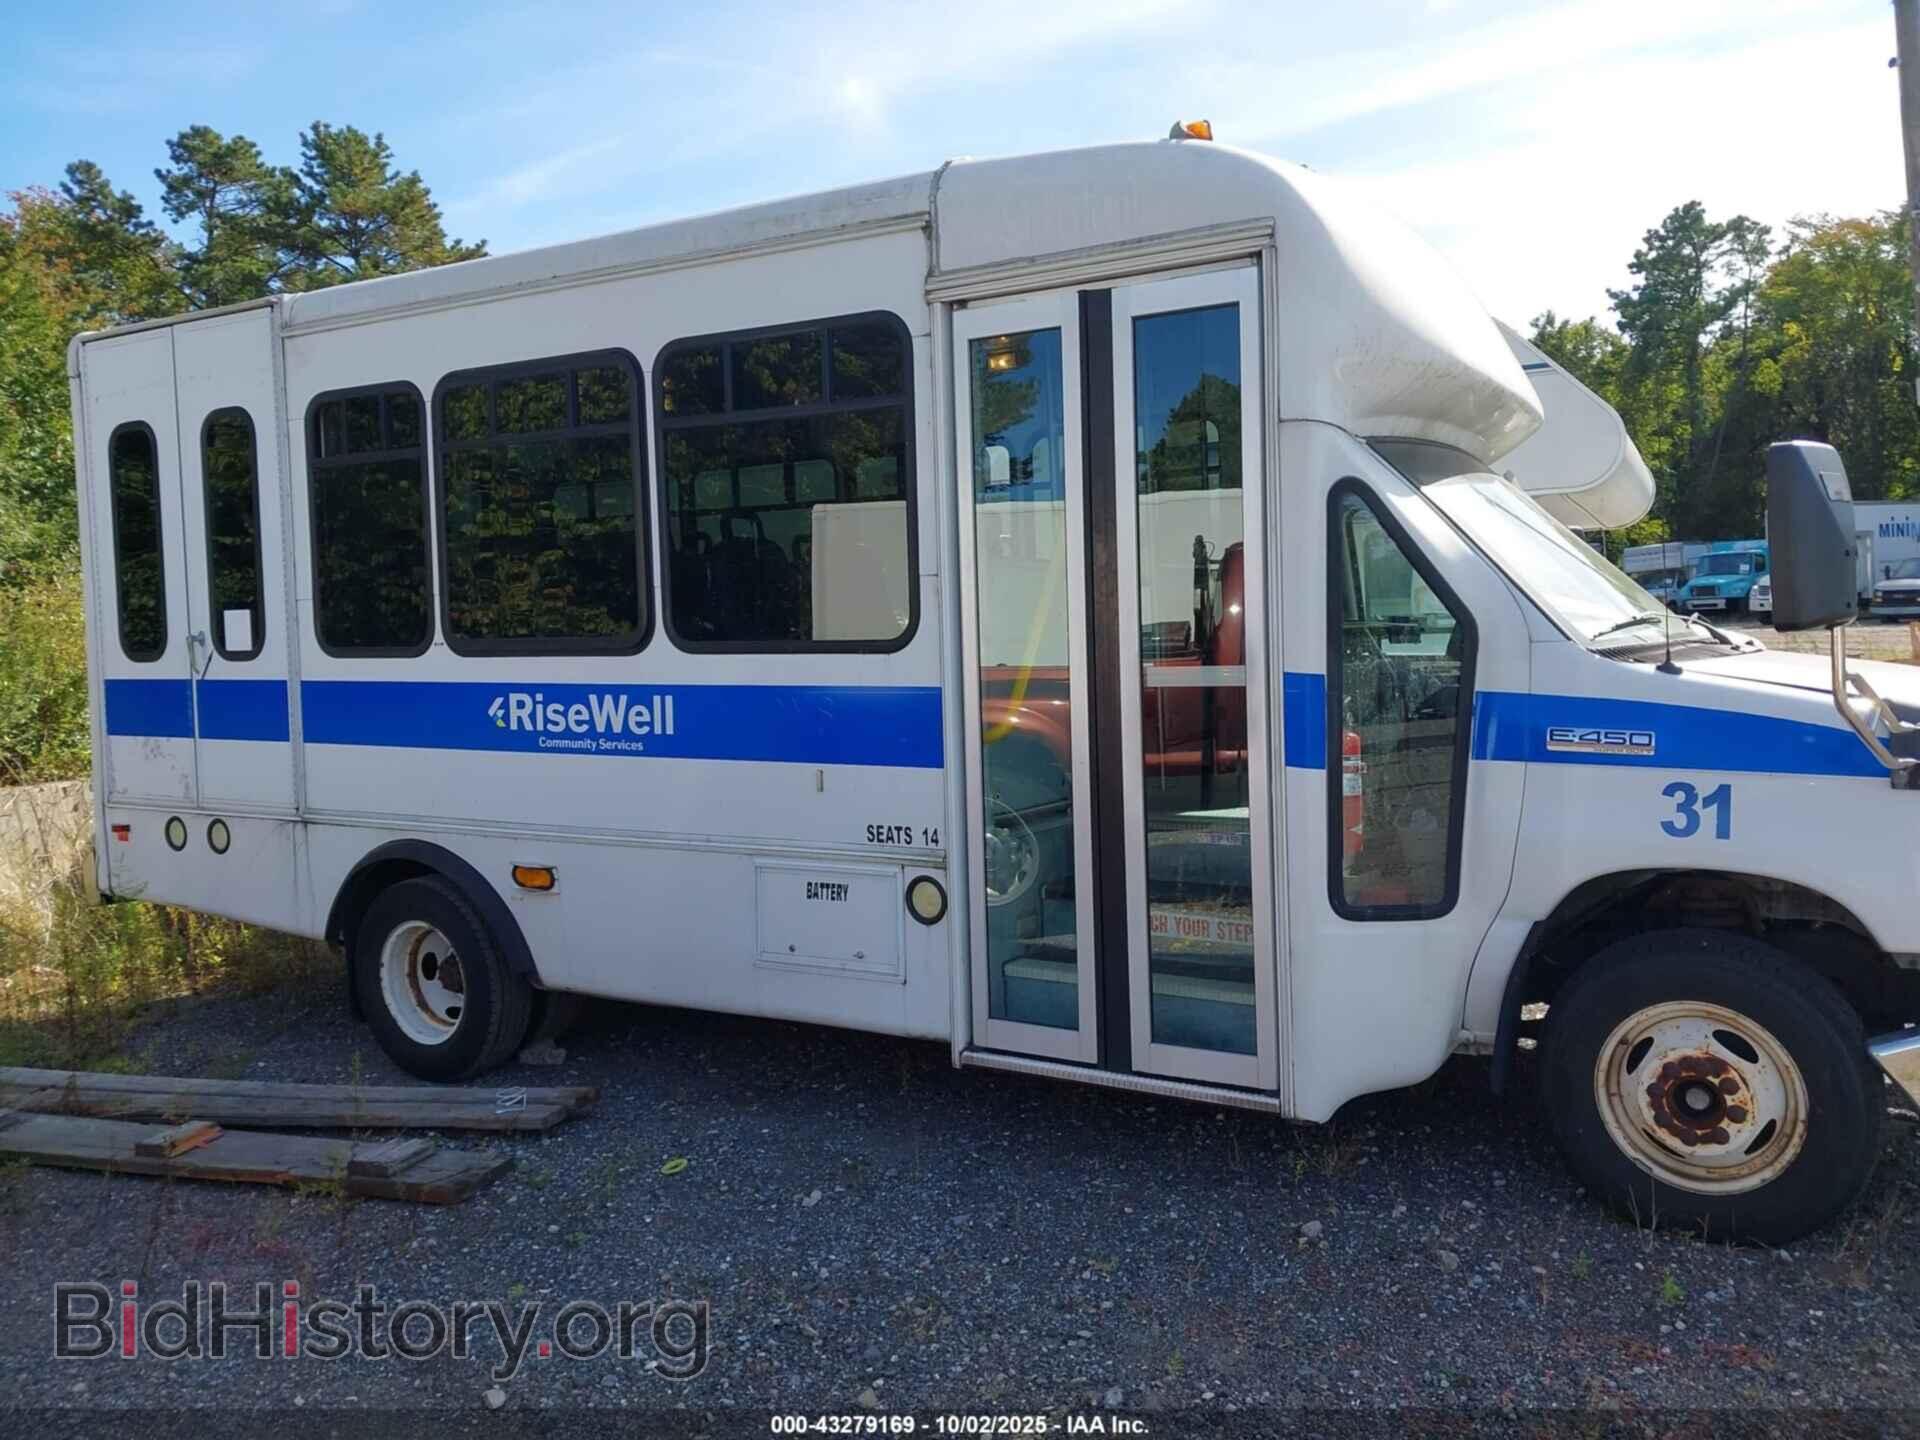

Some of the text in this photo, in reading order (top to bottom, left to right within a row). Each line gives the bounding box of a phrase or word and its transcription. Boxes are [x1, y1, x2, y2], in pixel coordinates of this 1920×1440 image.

[508, 692, 674, 735] RiseWell
[538, 736, 644, 751] Community Services
[1549, 728, 1653, 747] E-450
[1659, 781, 1732, 841] 31
[866, 824, 939, 847] SEATS 14
[806, 881, 849, 902] BATTERY
[1174, 914, 1210, 938] YOUR
